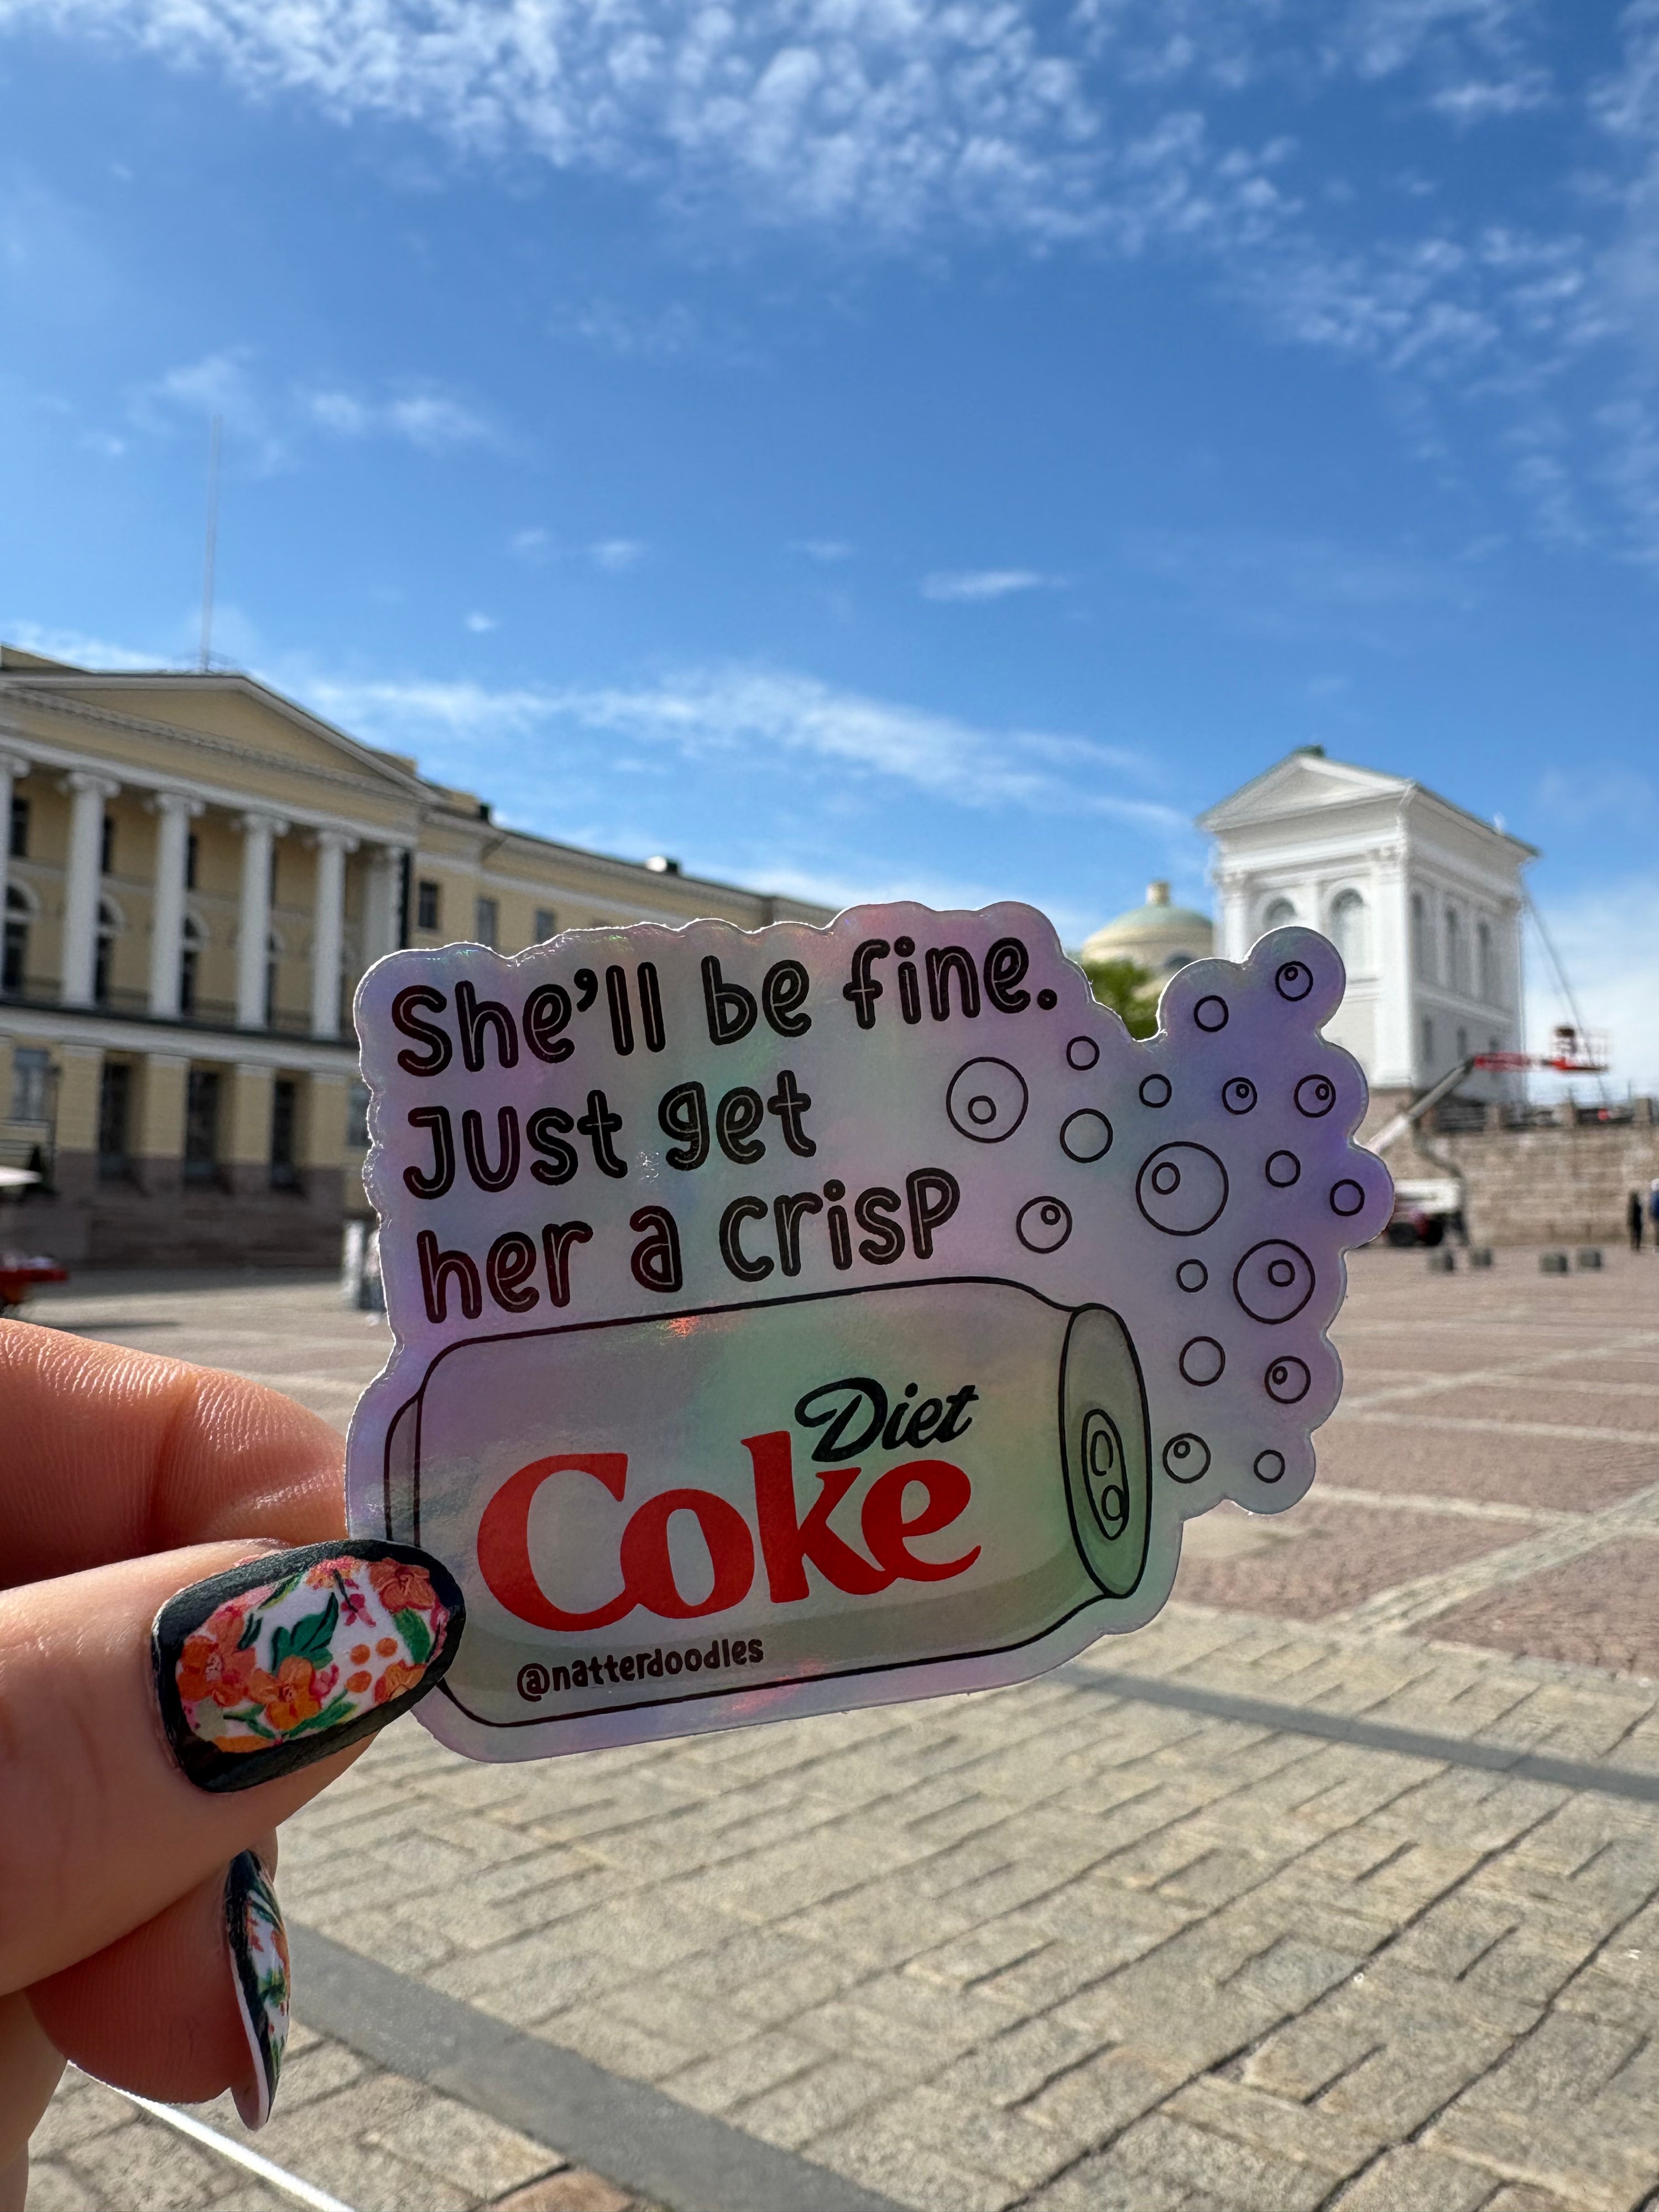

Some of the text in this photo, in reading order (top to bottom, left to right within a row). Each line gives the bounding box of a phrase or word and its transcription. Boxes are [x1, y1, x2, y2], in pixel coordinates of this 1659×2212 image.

[392, 936, 1058, 1077] She'll be fine.
[659, 1070, 817, 1171] get
[417, 1220, 593, 1324] her
[630, 1205, 683, 1293] a
[794, 1376, 979, 1463] Diet
[477, 1430, 982, 1632] Coke
[517, 1637, 765, 1703] @natterdoodles
